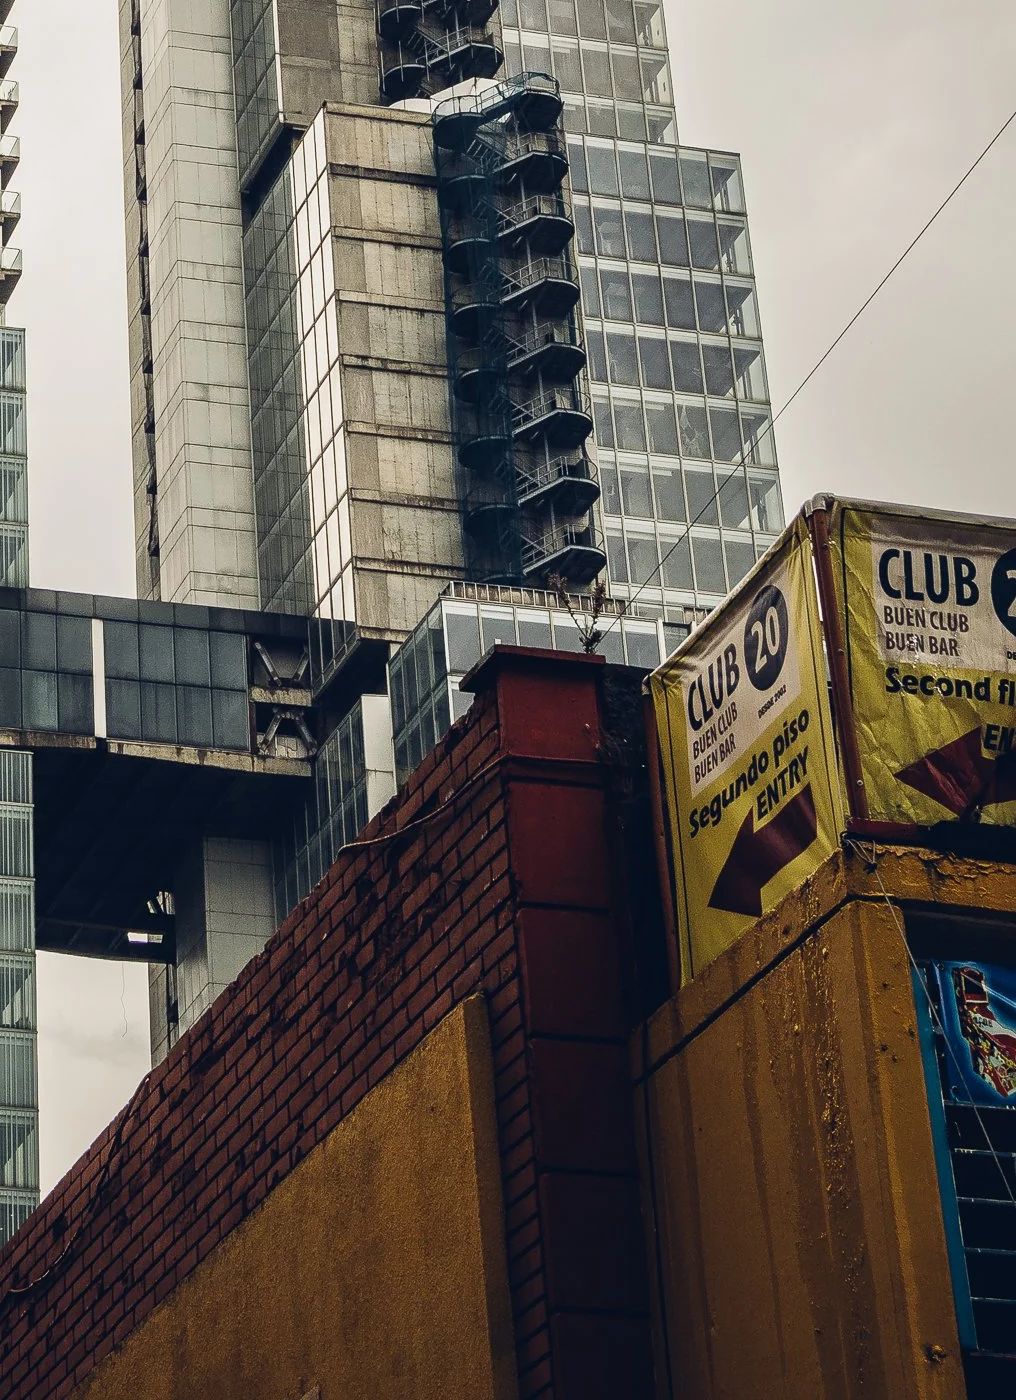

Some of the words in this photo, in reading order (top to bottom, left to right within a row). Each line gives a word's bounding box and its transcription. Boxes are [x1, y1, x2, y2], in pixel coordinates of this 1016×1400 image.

[878, 548, 980, 607] CLUB
[883, 605, 926, 628] BUEN
[930, 611, 969, 633] CLUB
[885, 631, 925, 653] BUEN
[929, 636, 960, 657] BAR
[687, 643, 740, 731] CLUB
[751, 606, 780, 674] 20
[885, 666, 991, 702] Second
[693, 724, 717, 760] BUEN
[718, 701, 738, 737] CLUB
[758, 696, 774, 719] DESDE
[689, 749, 769, 838] Segundo
[773, 709, 810, 768] piso
[694, 752, 719, 784] BUEN
[719, 733, 737, 765] BAR
[756, 745, 809, 822] ENTRY
